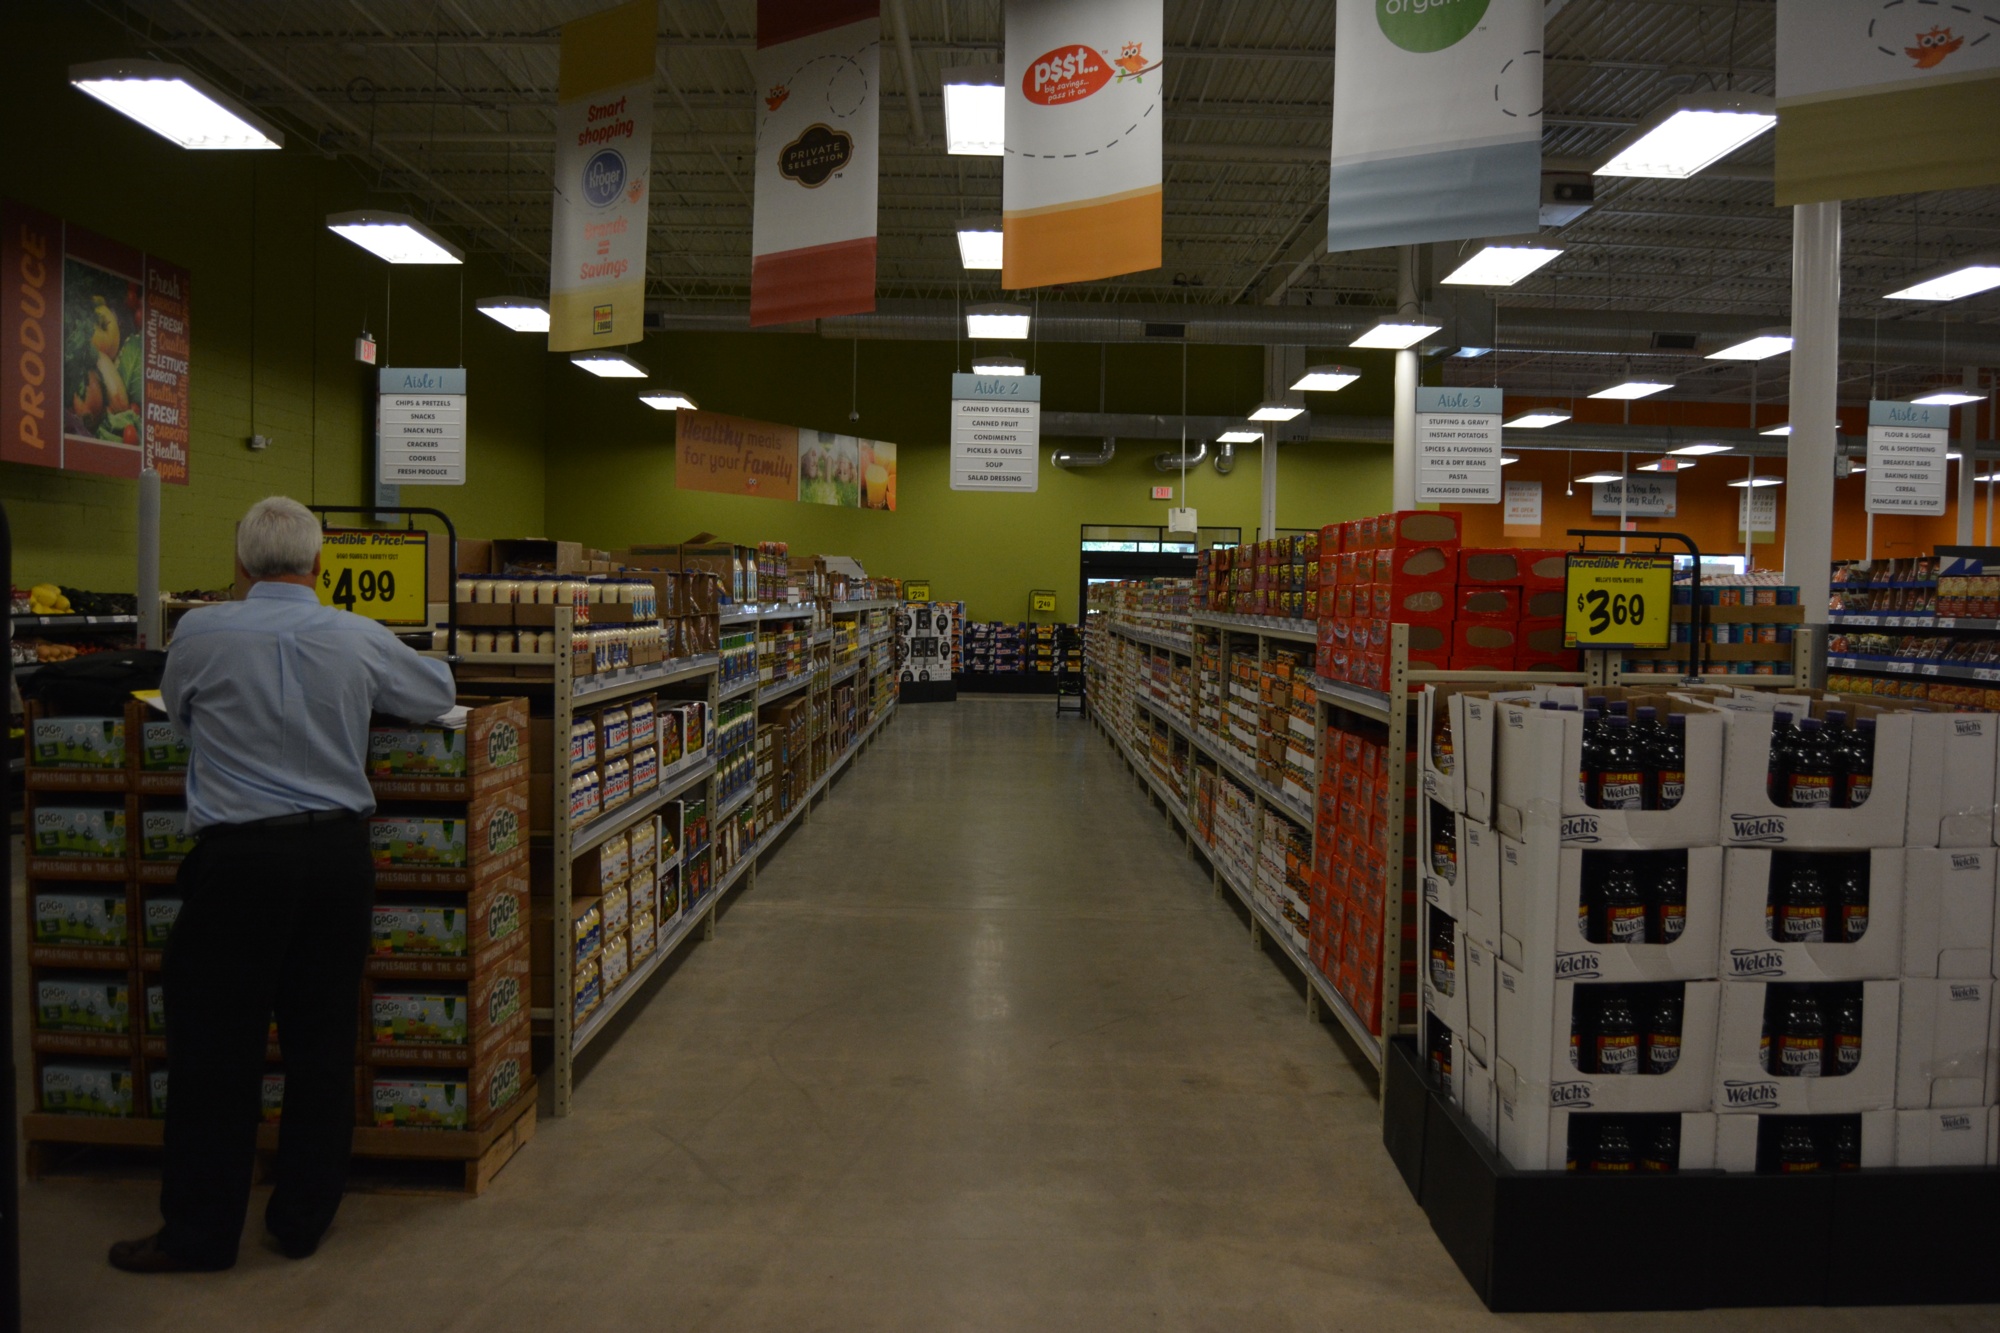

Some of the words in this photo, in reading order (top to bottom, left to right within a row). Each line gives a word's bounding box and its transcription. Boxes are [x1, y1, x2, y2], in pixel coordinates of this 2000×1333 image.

[1044, 84, 1055, 94] big
[1048, 92, 1066, 104] pass
[1068, 88, 1076, 97] it
[1077, 88, 1087, 96] on
[587, 95, 627, 123] Smart
[578, 118, 634, 146] shopping
[790, 142, 841, 161] PRIVATE
[788, 152, 844, 170] SELECTION
[589, 161, 621, 197] Kroger
[584, 214, 628, 240] Brands
[579, 258, 628, 280] Savings
[148, 268, 181, 300] Fresh
[159, 314, 183, 335] FRESH
[19, 224, 47, 450] PRODUCE
[149, 310, 159, 364] Healthy
[157, 357, 189, 375] LETTUCE
[147, 367, 177, 386] CARROTS
[403, 373, 434, 389] Aisle
[147, 382, 178, 408] Healthy
[974, 379, 1006, 395] Aisle
[1437, 392, 1468, 408] Aisle
[147, 403, 180, 426] FRESH
[962, 405, 990, 413] CANNED
[991, 406, 1030, 414] VEGETABLES
[1889, 407, 1918, 422] Aisle
[155, 425, 189, 443] CARROTS
[682, 414, 744, 453] Healthy
[747, 432, 783, 450] meals
[155, 441, 187, 466] Healthy
[156, 462, 186, 479] Apples
[418, 468, 447, 476] PRODUCE
[684, 447, 706, 467] for
[709, 453, 741, 473] your
[743, 450, 793, 484] Family
[1156, 487, 1170, 498] EXIT
[1607, 483, 1631, 494] Thak
[1631, 484, 1646, 494] You
[1649, 483, 1661, 494] for
[1603, 493, 1638, 506] Shoping
[1641, 495, 1665, 505] Ruler
[371, 535, 405, 546] Price!
[1568, 557, 1620, 569] Incredible
[1623, 558, 1653, 570] Price!
[146, 727, 172, 739] GoGo
[373, 734, 398, 746] GoGo
[489, 723, 515, 764] GoGo
[1617, 773, 1638, 781] FREE
[1808, 776, 1829, 784] FREE
[420, 783, 431, 793] ON
[436, 783, 450, 793] THE
[454, 783, 465, 793] GO
[1605, 785, 1639, 798] Welch's
[1795, 787, 1829, 800] Welch's
[37, 812, 62, 825] GoGo
[146, 817, 171, 829] GoGo
[372, 825, 397, 836] GoGo
[489, 809, 515, 852] GoGo
[1733, 818, 1784, 836] Welch's
[39, 901, 63, 913] GoGo
[148, 905, 173, 918] GoGo
[1626, 906, 1643, 915] FREE
[1799, 907, 1820, 915] FREE
[374, 914, 398, 926] GoGo
[488, 894, 515, 938] GoGo
[1615, 919, 1644, 933] Welch's
[1787, 918, 1821, 932] Welch's
[370, 961, 417, 971] APPLESAUCE
[422, 962, 433, 972] ON
[436, 962, 451, 972] THE
[455, 963, 467, 973] GO
[1732, 952, 1783, 972] Welch's
[375, 1002, 399, 1014] GoGo
[489, 978, 515, 1024] GoGo
[1615, 1036, 1634, 1044] FREE
[1604, 1048, 1636, 1061] Welch's
[1784, 1050, 1819, 1063] Welch's
[490, 1060, 516, 1107] GoGo
[1726, 1085, 1777, 1103] Welch's
